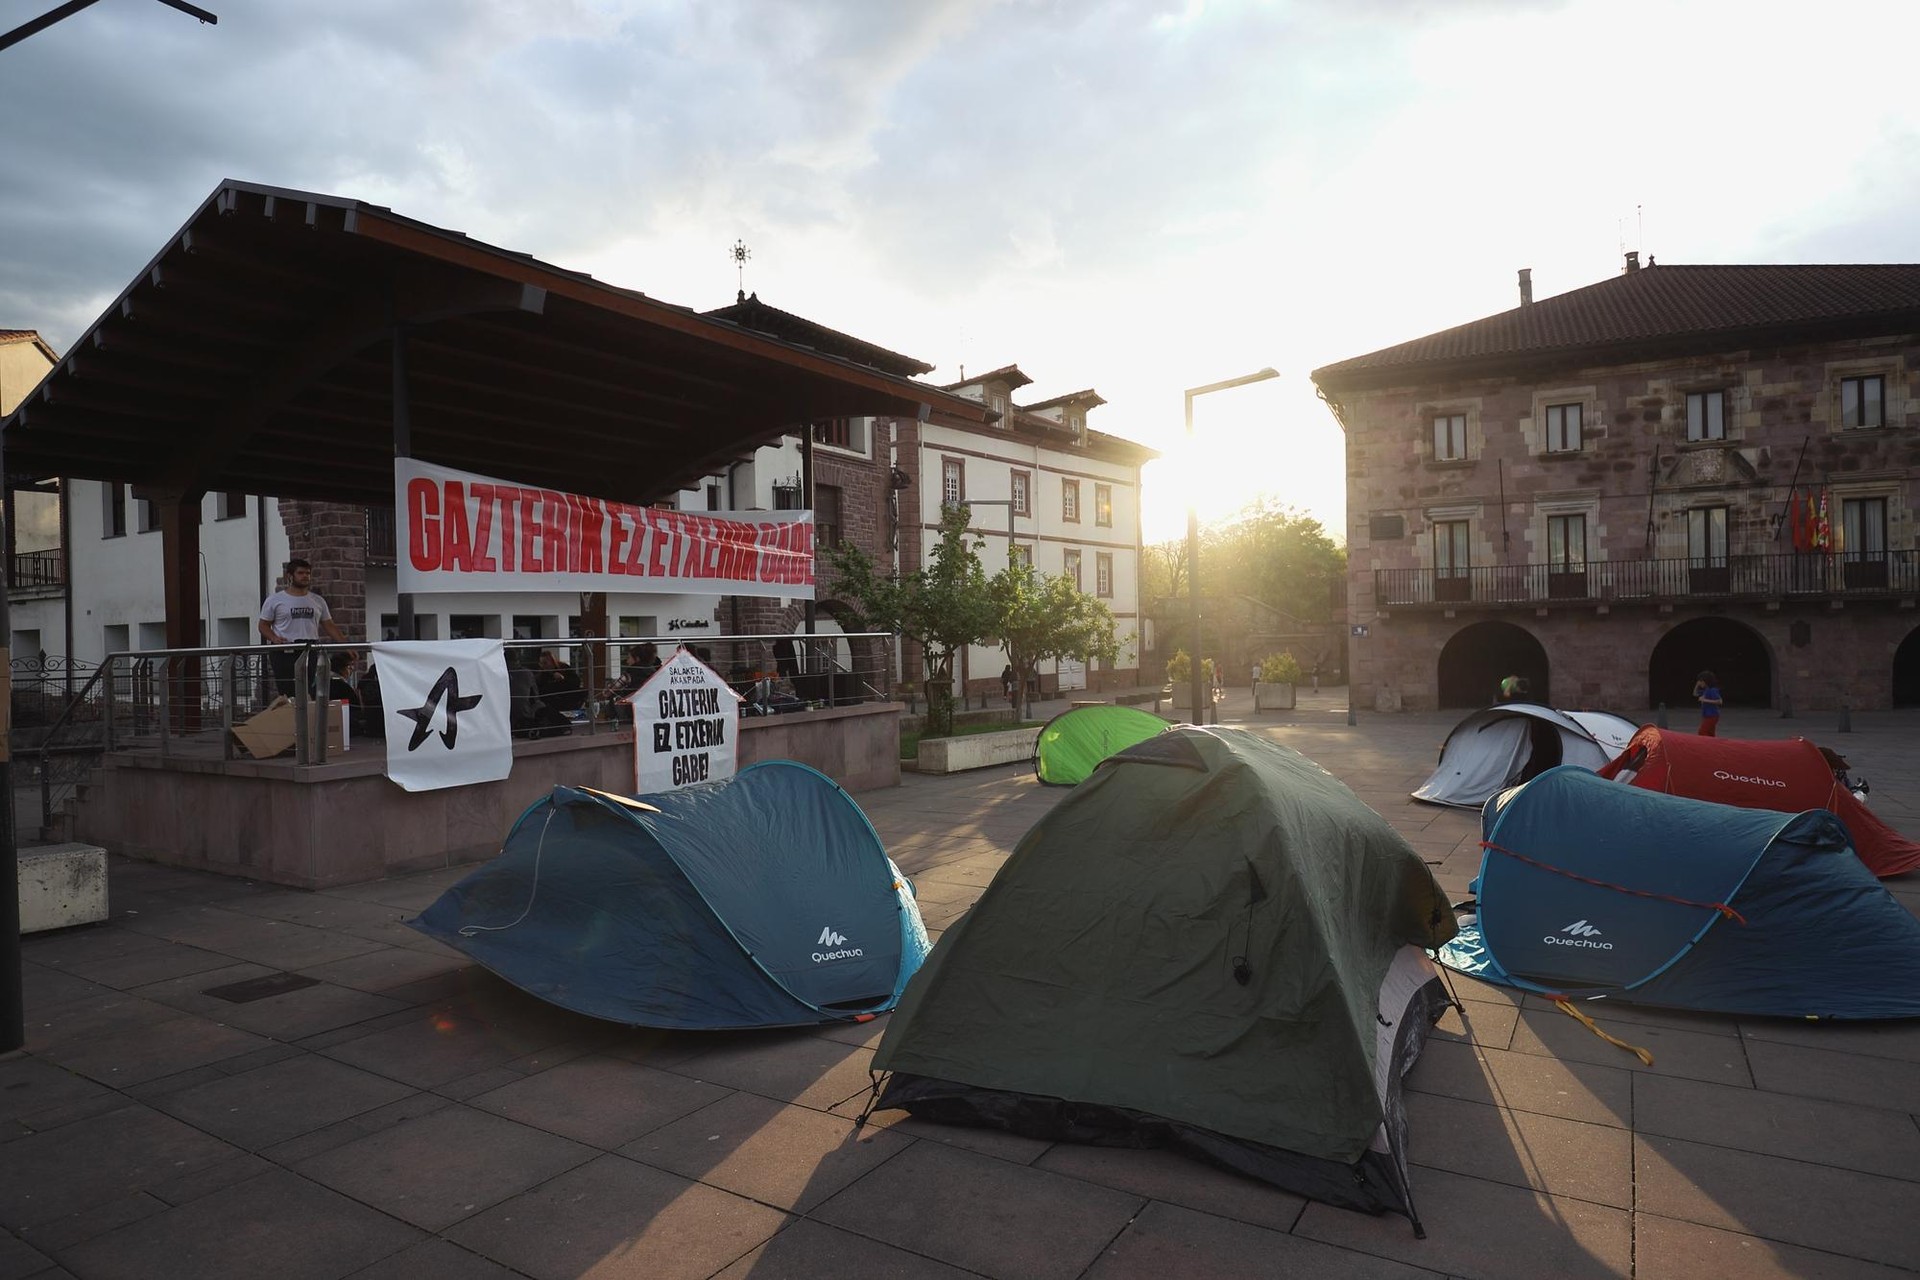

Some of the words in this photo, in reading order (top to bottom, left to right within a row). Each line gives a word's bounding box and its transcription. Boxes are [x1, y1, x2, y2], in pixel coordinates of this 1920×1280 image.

[407, 477, 603, 573] GAZTERIK
[604, 498, 646, 577] EZ
[669, 666, 705, 676] SALAKETA
[658, 688, 720, 719] GAZTERIK
[653, 722, 672, 753] EZ
[675, 718, 725, 749] ETXERIK
[672, 752, 709, 786] GABE!
[1713, 770, 1786, 788] Quechua
[1543, 935, 1613, 950] Quechua
[811, 948, 863, 963] Quechua
